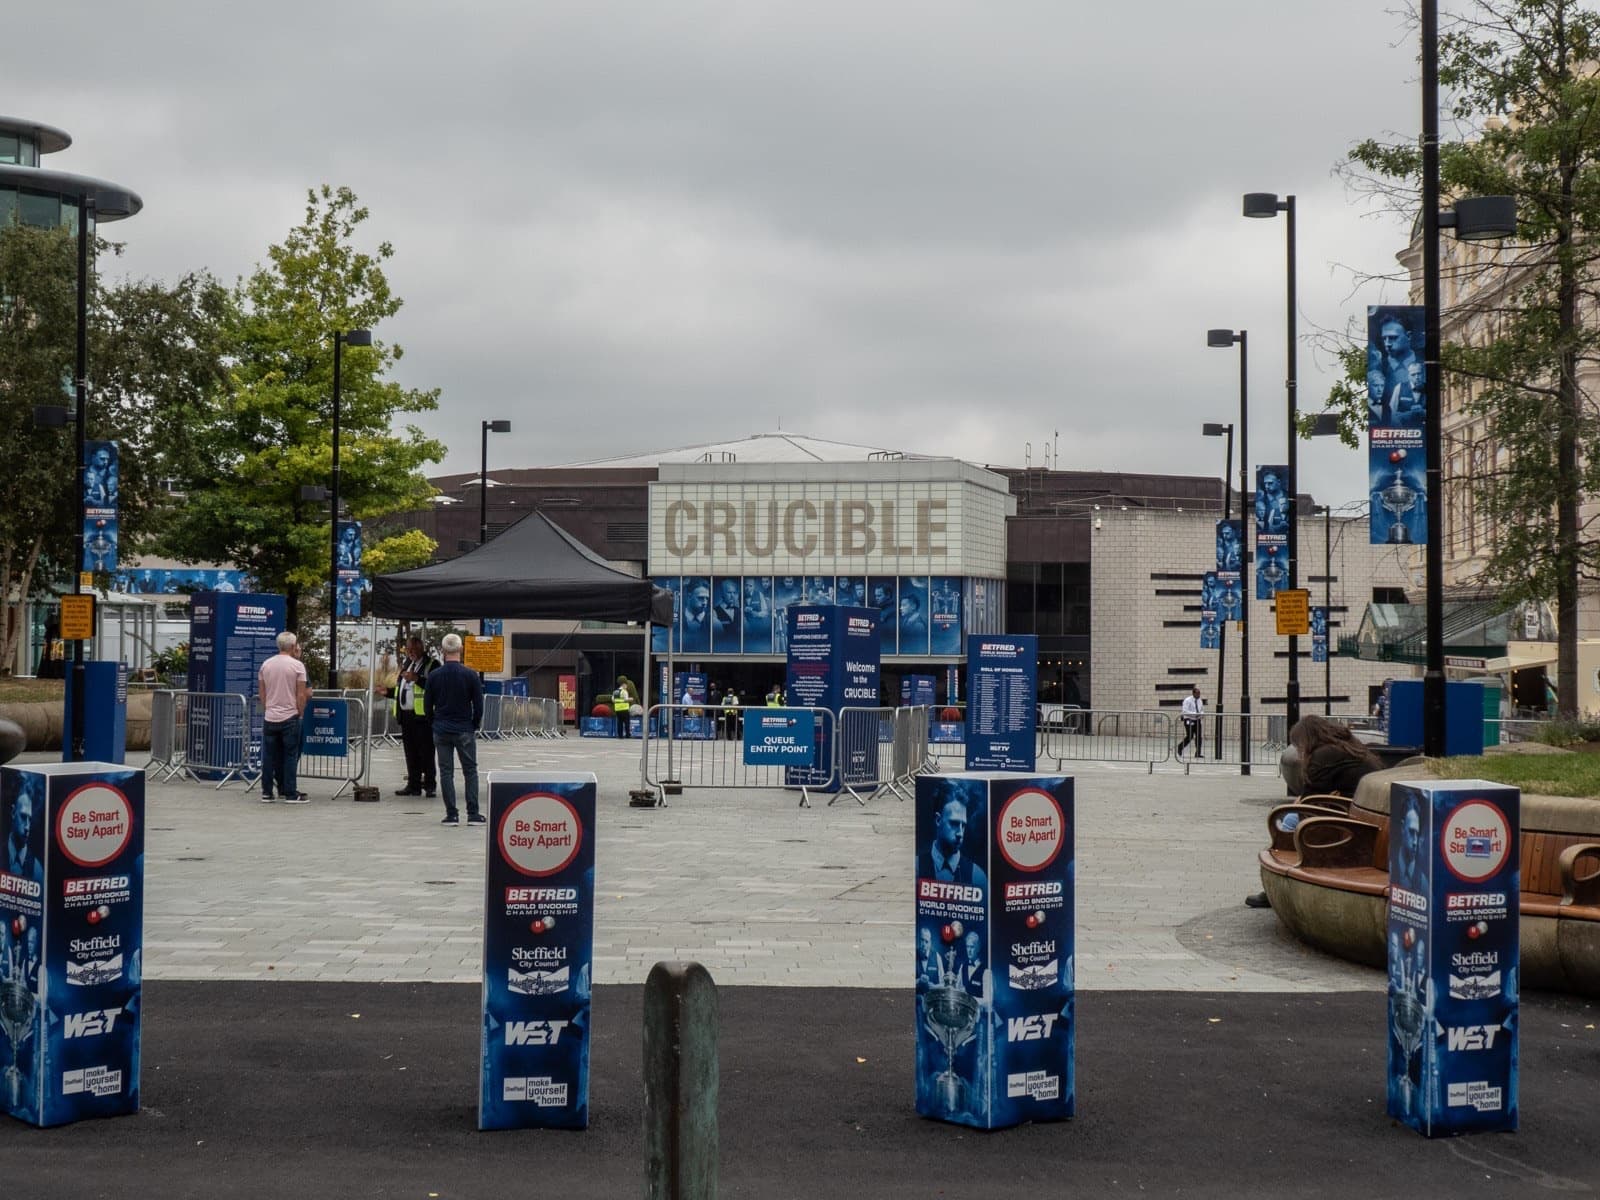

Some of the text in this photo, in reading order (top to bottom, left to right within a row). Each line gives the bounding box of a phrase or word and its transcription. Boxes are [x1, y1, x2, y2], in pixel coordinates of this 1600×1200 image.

[1372, 429, 1421, 438] BETFRED
[664, 499, 948, 558] CRUCIBLE
[238, 606, 266, 615] BETFRED
[982, 643, 1015, 651] BETFRED
[846, 661, 876, 673] Welcome
[859, 675, 868, 684] the
[844, 688, 876, 699] CRUCIBLE
[315, 727, 334, 735] QUEUE
[306, 736, 343, 744] ENTRY POINT
[764, 736, 795, 744] QUEUE
[750, 745, 808, 753] ENTRY POINT
[72, 811, 119, 824] Be Smart
[1011, 815, 1052, 828] Be Smart
[67, 823, 124, 840] Stay Apart!
[515, 820, 567, 832] Be Smart
[1455, 826, 1498, 839] Be Smart
[509, 834, 571, 849] Stay Apart!
[1006, 830, 1056, 845] Stay Apart!
[1450, 841, 1467, 854] Sta
[0, 873, 40, 897] BETFRED
[66, 876, 129, 893] BETFRED
[1007, 882, 1062, 898] BETFRED
[64, 890, 130, 902] WORLD SNOOKER
[508, 889, 577, 901] BETFRED
[920, 882, 983, 902] BETFRED
[64, 897, 130, 909] CHAMPIONSHIP
[1006, 896, 1063, 906] WORLD SNOOKER
[1391, 887, 1427, 911] BETFRED
[1448, 894, 1506, 907] BETFRED
[919, 900, 984, 914] WORLD SNOOKER
[1006, 903, 1063, 912] CHAMPIONSHIP
[919, 908, 984, 921] CHAMPIONSHIP
[1447, 914, 1507, 922] CHAMPIONSHIP
[70, 935, 120, 952] Sheffield
[1011, 940, 1056, 957] Sheffield
[76, 949, 114, 960] City Council
[512, 947, 566, 960] Sheffield
[1017, 954, 1050, 964] City Council
[1452, 952, 1498, 966] Sheffield
[519, 960, 560, 968] City Council
[64, 1007, 122, 1039] WST
[1008, 1013, 1058, 1042] WST
[505, 1020, 569, 1046] WST
[1448, 1025, 1501, 1051] WST
[86, 1068, 105, 1077] make
[1028, 1073, 1045, 1082] make
[86, 1072, 120, 1089] yourself
[1028, 1078, 1057, 1092] yourself
[97, 1083, 120, 1094] home
[528, 1085, 566, 1098] yourself
[1038, 1089, 1058, 1098] home
[541, 1096, 566, 1105] home
[1469, 1090, 1500, 1103] yourself
[1479, 1100, 1500, 1109] home
